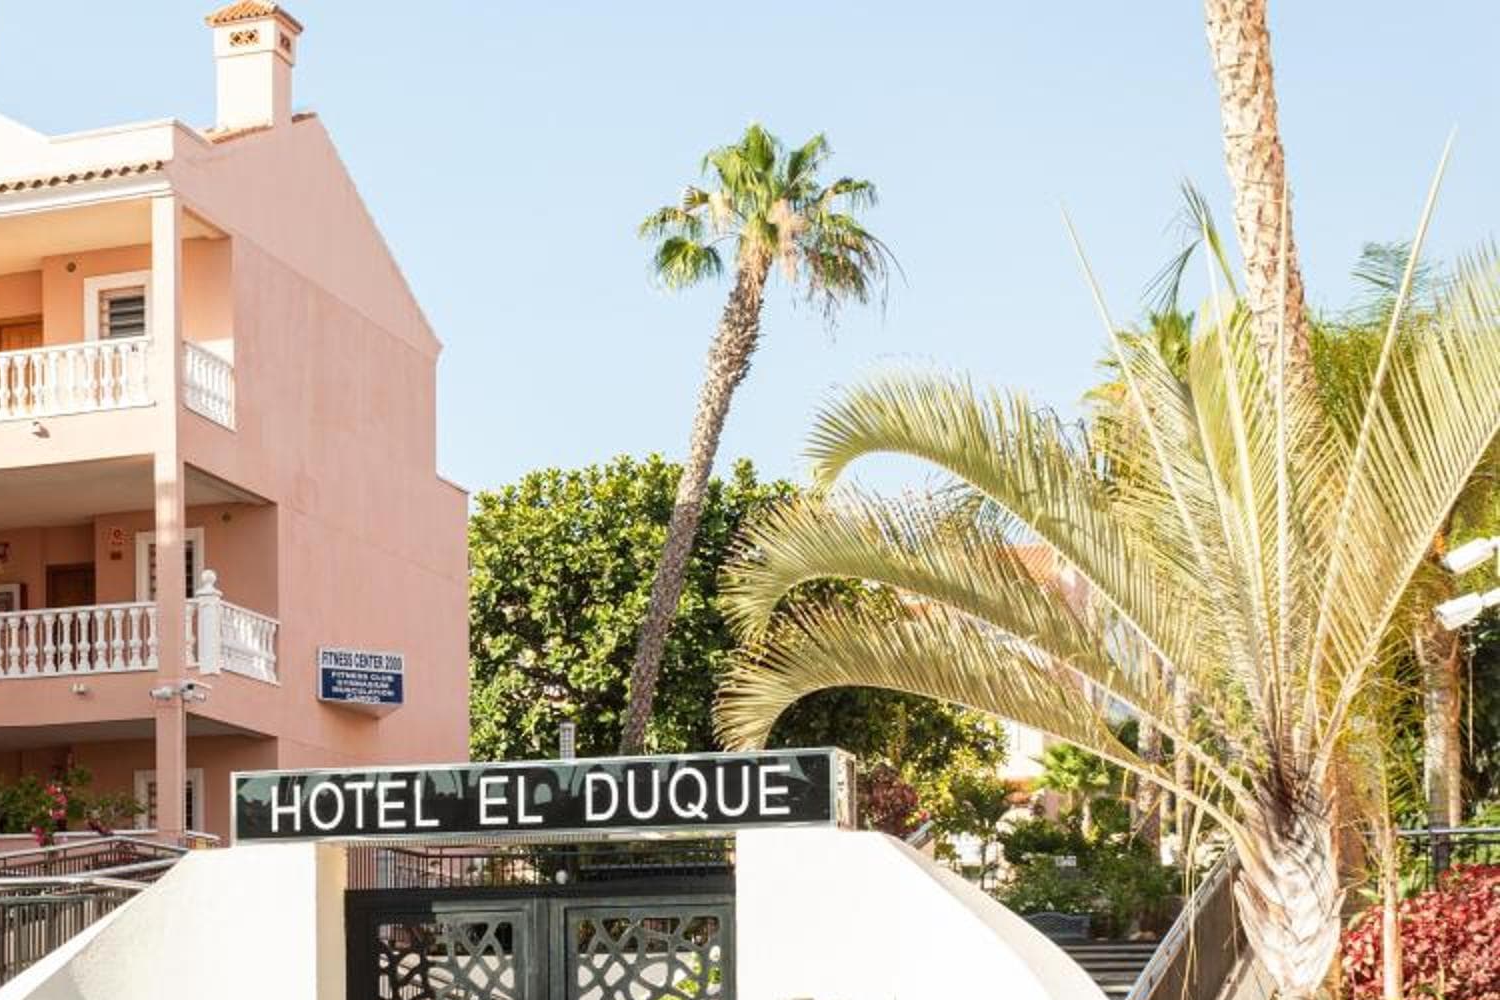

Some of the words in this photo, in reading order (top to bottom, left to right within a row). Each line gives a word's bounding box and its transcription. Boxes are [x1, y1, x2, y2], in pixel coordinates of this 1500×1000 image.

[322, 651, 352, 668] FITNESS
[354, 653, 383, 669] CENTER
[385, 655, 402, 670] 2000
[331, 671, 368, 680] FITNESS
[370, 674, 394, 682] CLUB
[270, 779, 439, 832] HOTEL
[479, 775, 543, 826] EL
[585, 765, 791, 822] DUQUE
